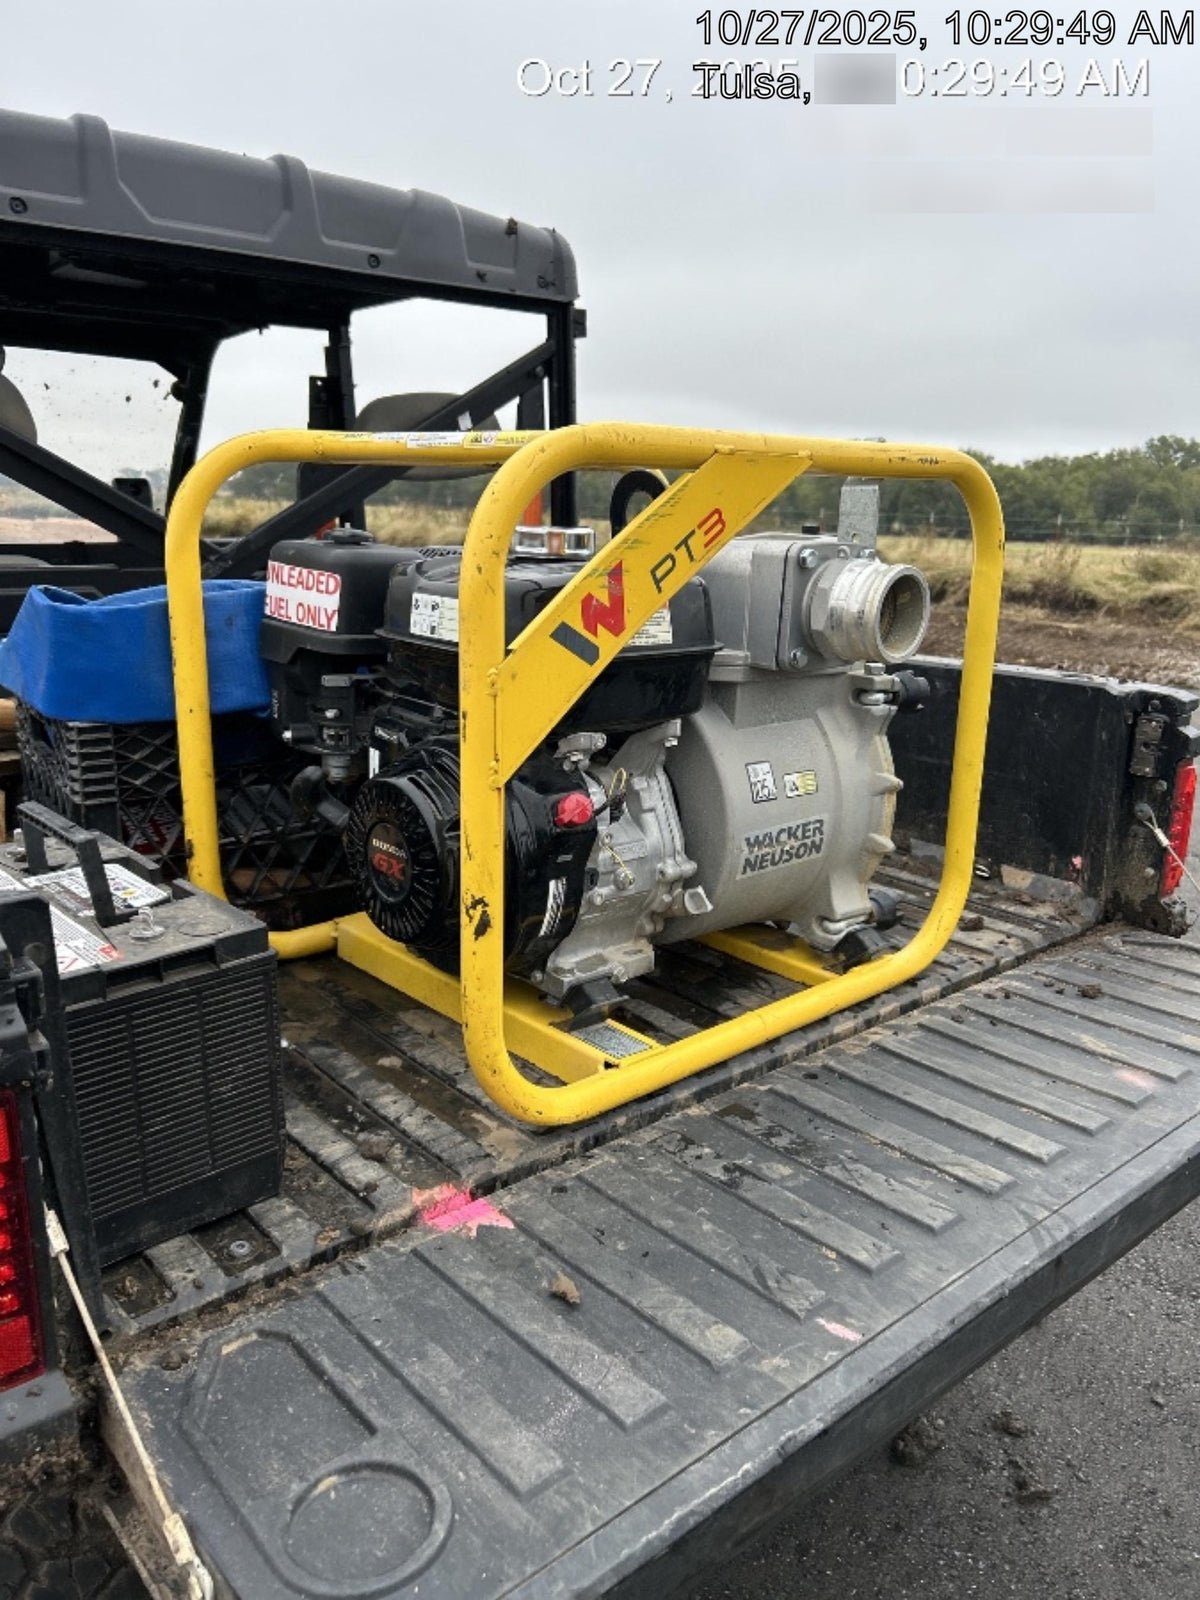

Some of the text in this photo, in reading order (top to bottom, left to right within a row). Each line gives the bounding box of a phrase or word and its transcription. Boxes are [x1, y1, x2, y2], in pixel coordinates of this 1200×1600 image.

[650, 507, 727, 594] PT3
[265, 593, 339, 631] UEL ONLY
[741, 836, 825, 876] NEUSON
[744, 818, 825, 856] WACKER
[371, 852, 406, 881] GX
